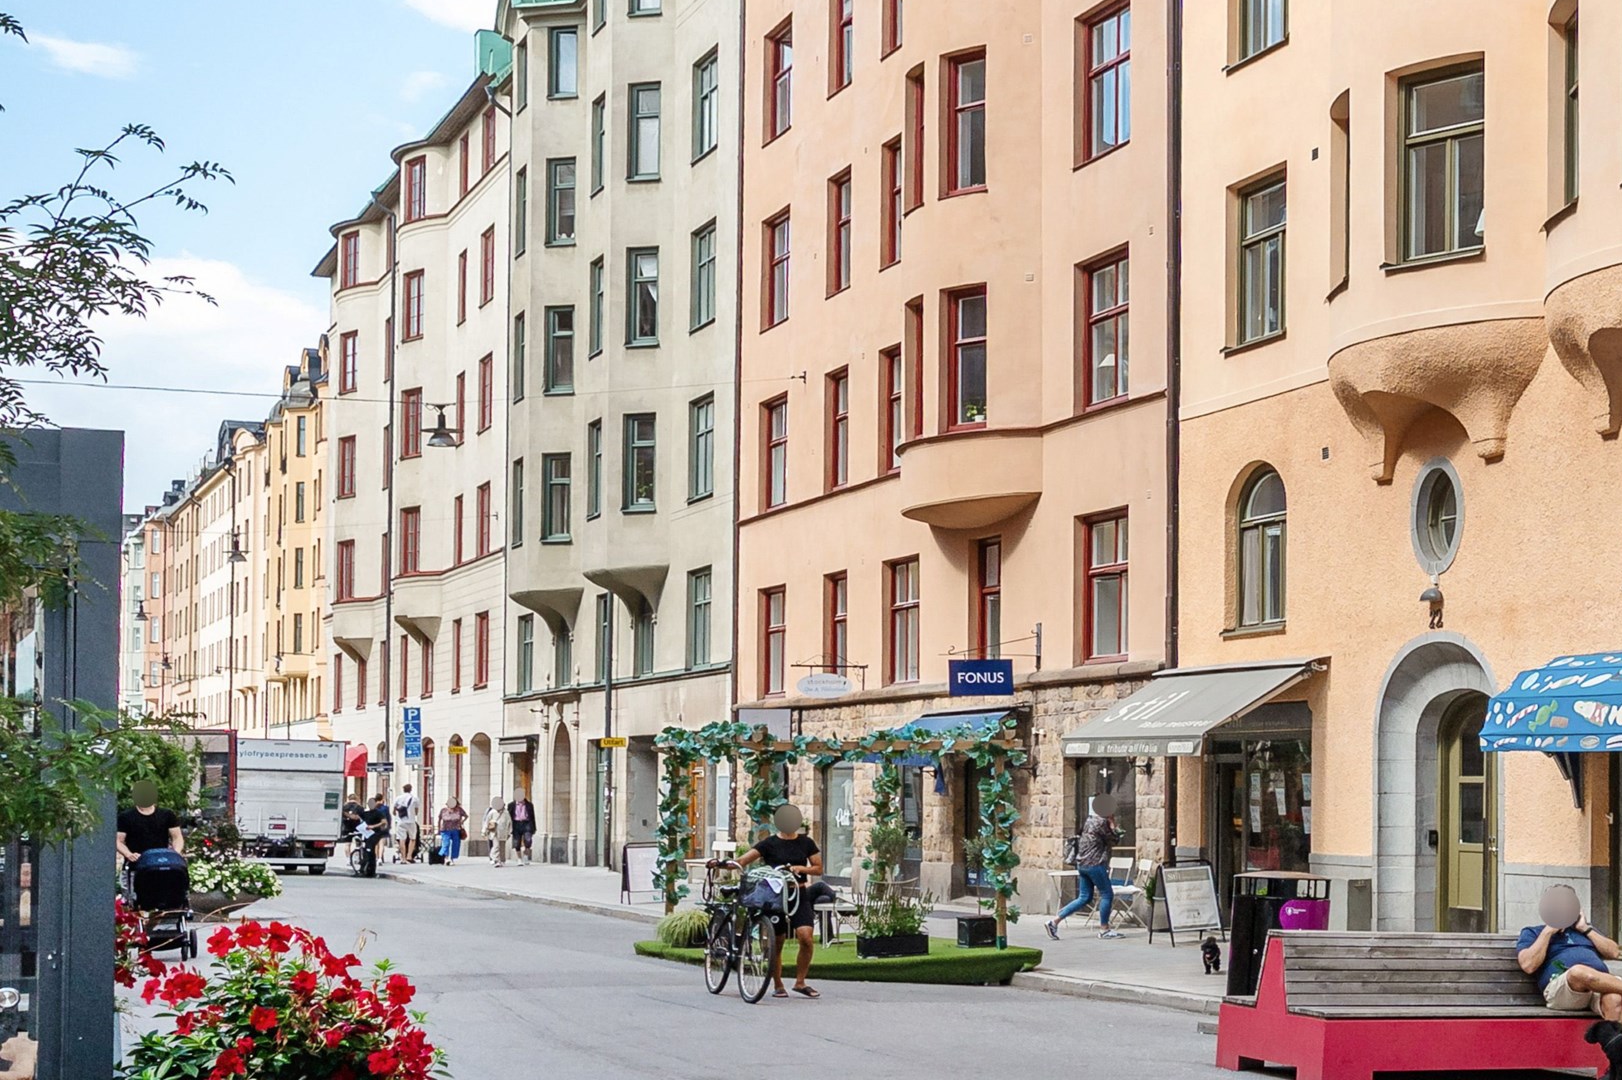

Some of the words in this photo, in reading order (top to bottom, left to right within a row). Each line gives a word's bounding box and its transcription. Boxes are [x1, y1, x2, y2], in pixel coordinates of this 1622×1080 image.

[957, 672, 1004, 684] FONUS
[408, 709, 418, 720] P
[239, 750, 328, 759] ylofrysexpressen.se
